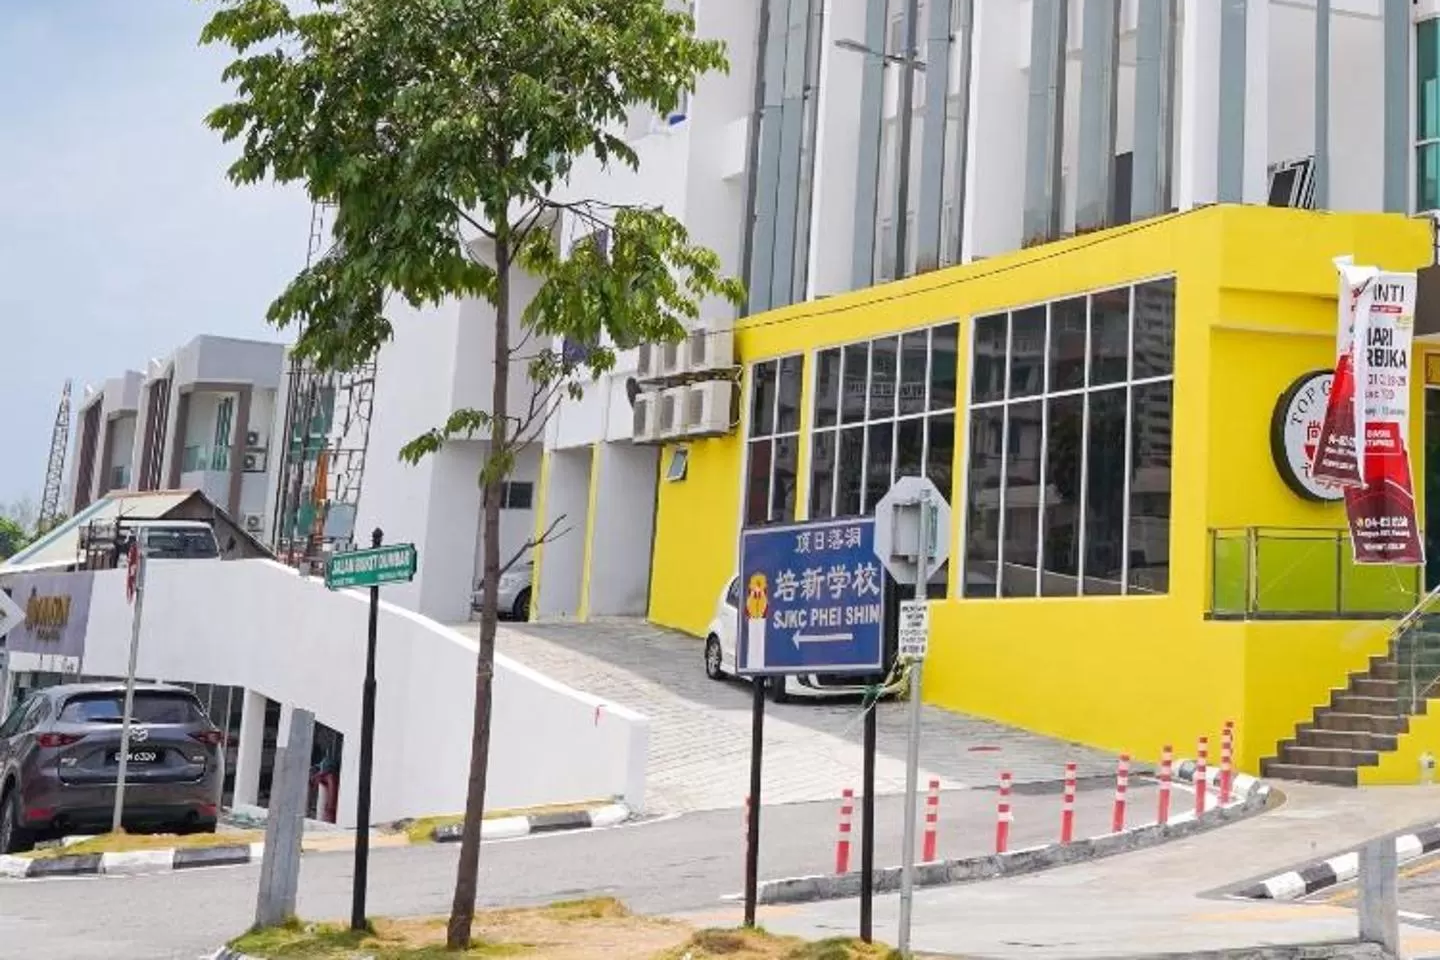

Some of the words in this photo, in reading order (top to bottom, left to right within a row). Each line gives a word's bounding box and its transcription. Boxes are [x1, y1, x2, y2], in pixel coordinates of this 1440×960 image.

[773, 561, 881, 602] 培新学校
[810, 606, 842, 627] PHEI
[845, 604, 881, 625] SHIN
